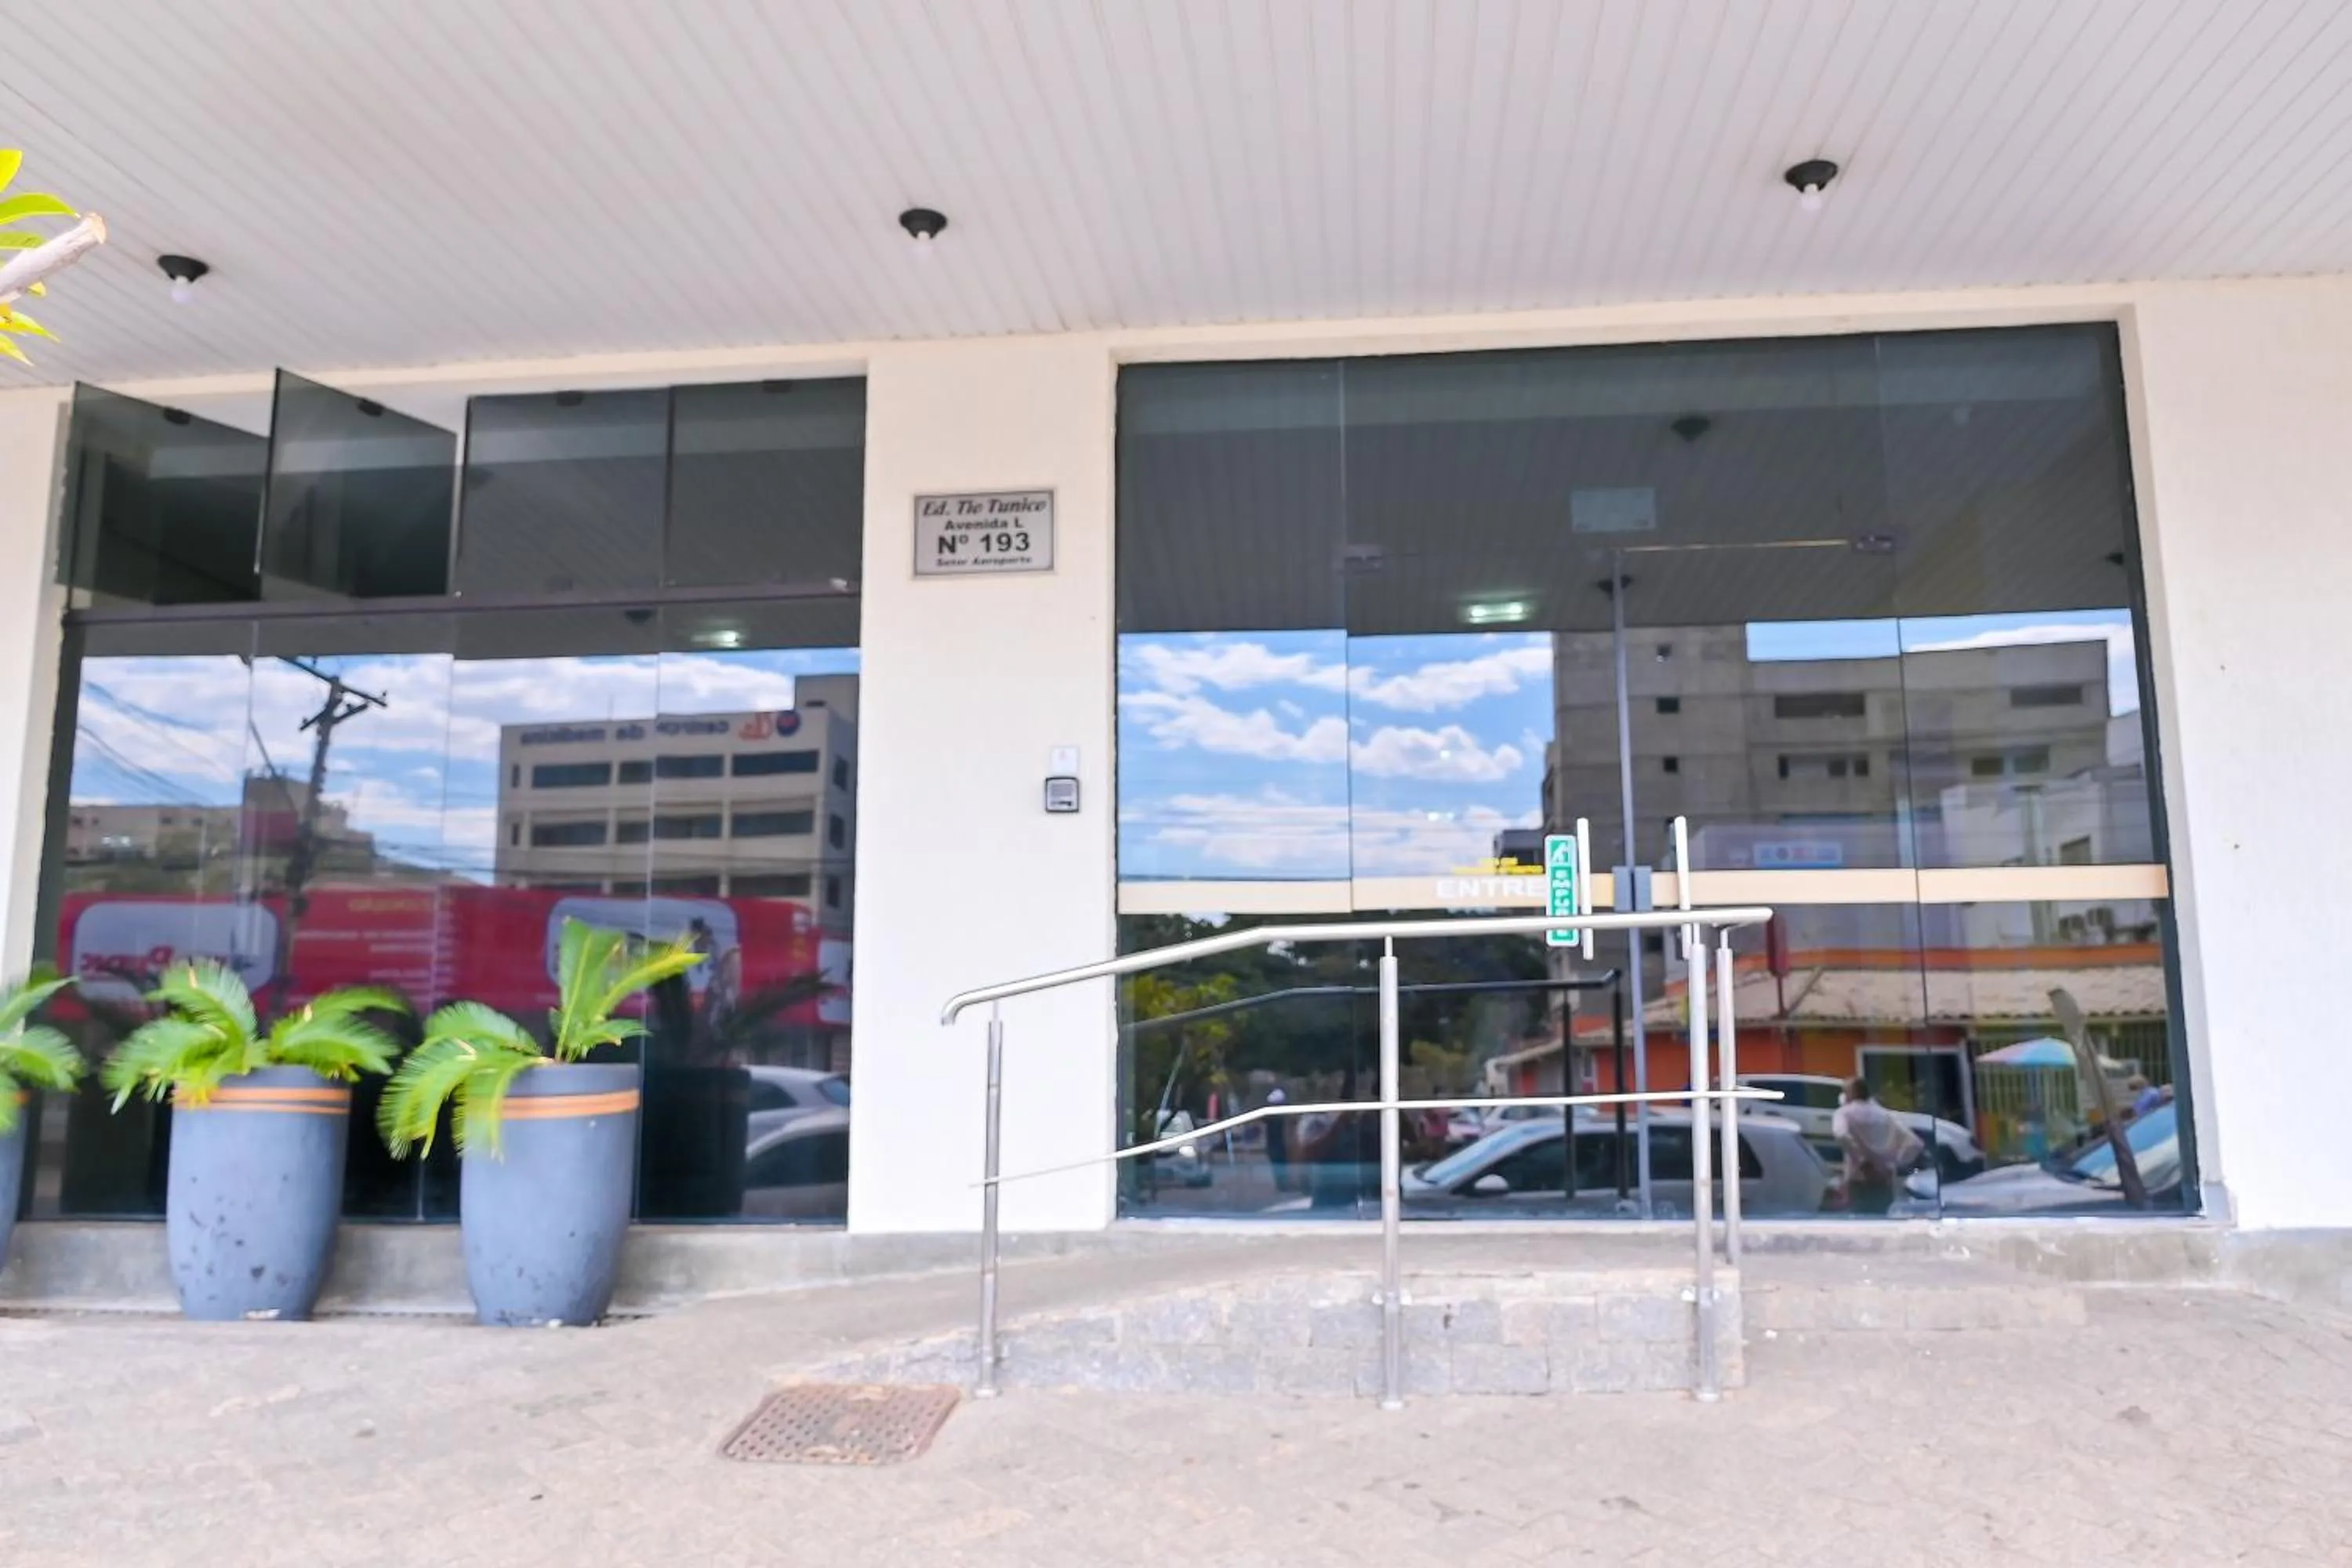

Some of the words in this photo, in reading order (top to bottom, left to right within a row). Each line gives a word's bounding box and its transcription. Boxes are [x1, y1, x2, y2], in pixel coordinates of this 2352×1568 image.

[923, 499, 950, 517] Ed.
[945, 518, 1008, 531] Avenida
[980, 532, 1030, 552] 193
[1436, 877, 1545, 899] ENTRE
